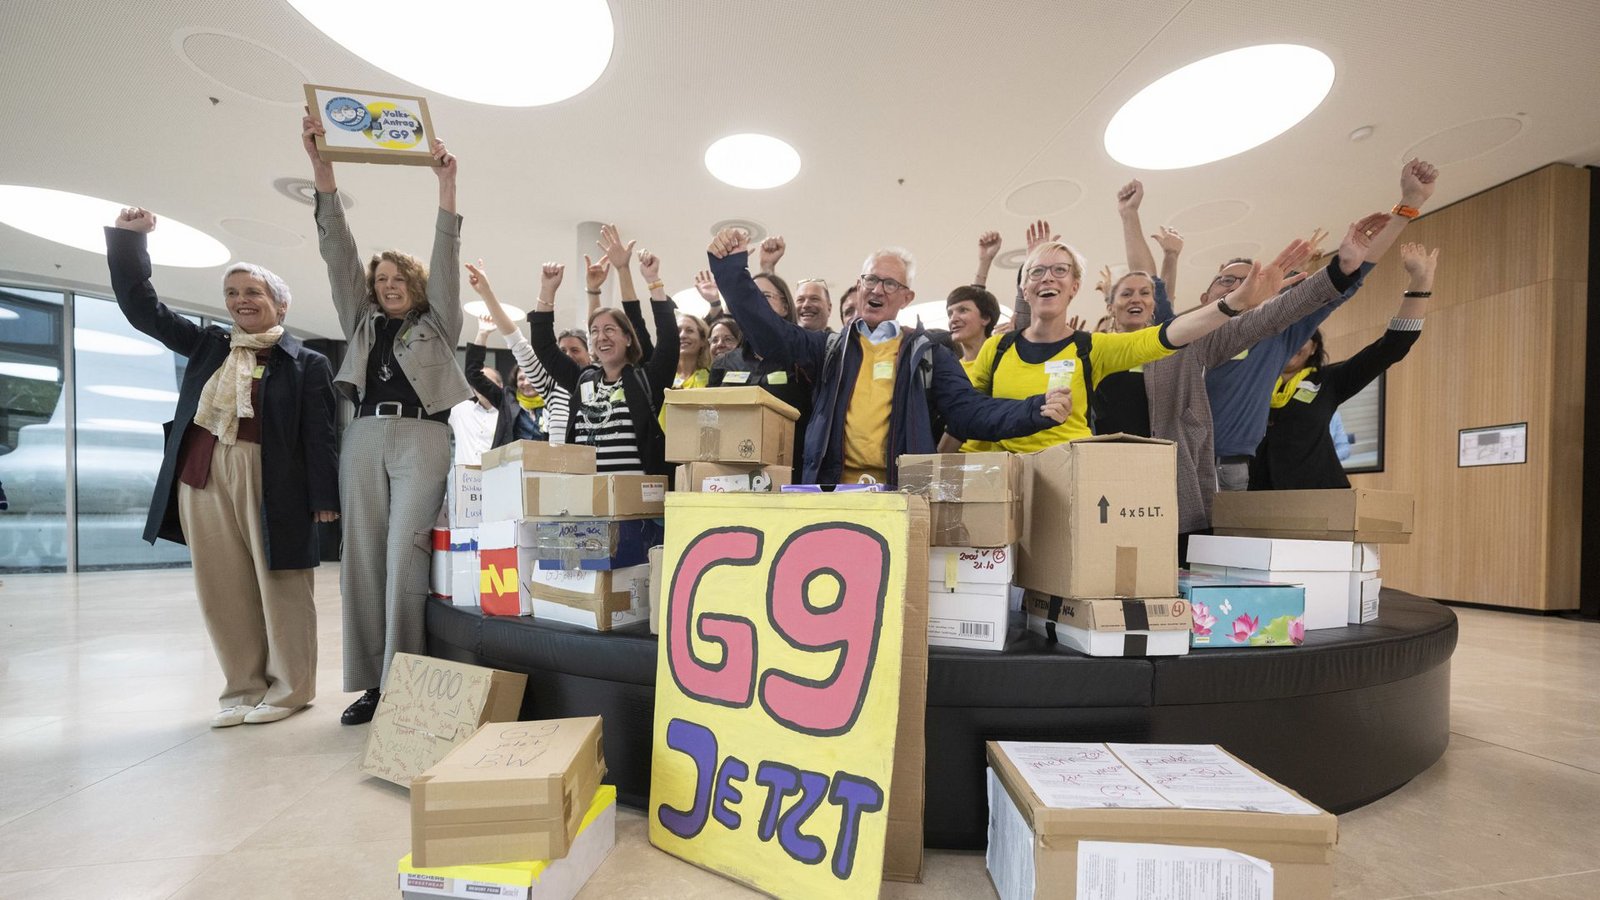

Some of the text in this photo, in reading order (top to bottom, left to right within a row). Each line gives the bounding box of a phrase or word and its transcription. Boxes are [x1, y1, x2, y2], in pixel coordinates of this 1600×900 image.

[382, 118, 415, 130] Antrag
[388, 129, 409, 140] G9
[1120, 508, 1127, 518] 4
[1129, 509, 1136, 518] x
[1138, 508, 1146, 518] 5
[667, 521, 891, 738] G9
[413, 664, 464, 700] 1000
[658, 719, 884, 880] JETZT
